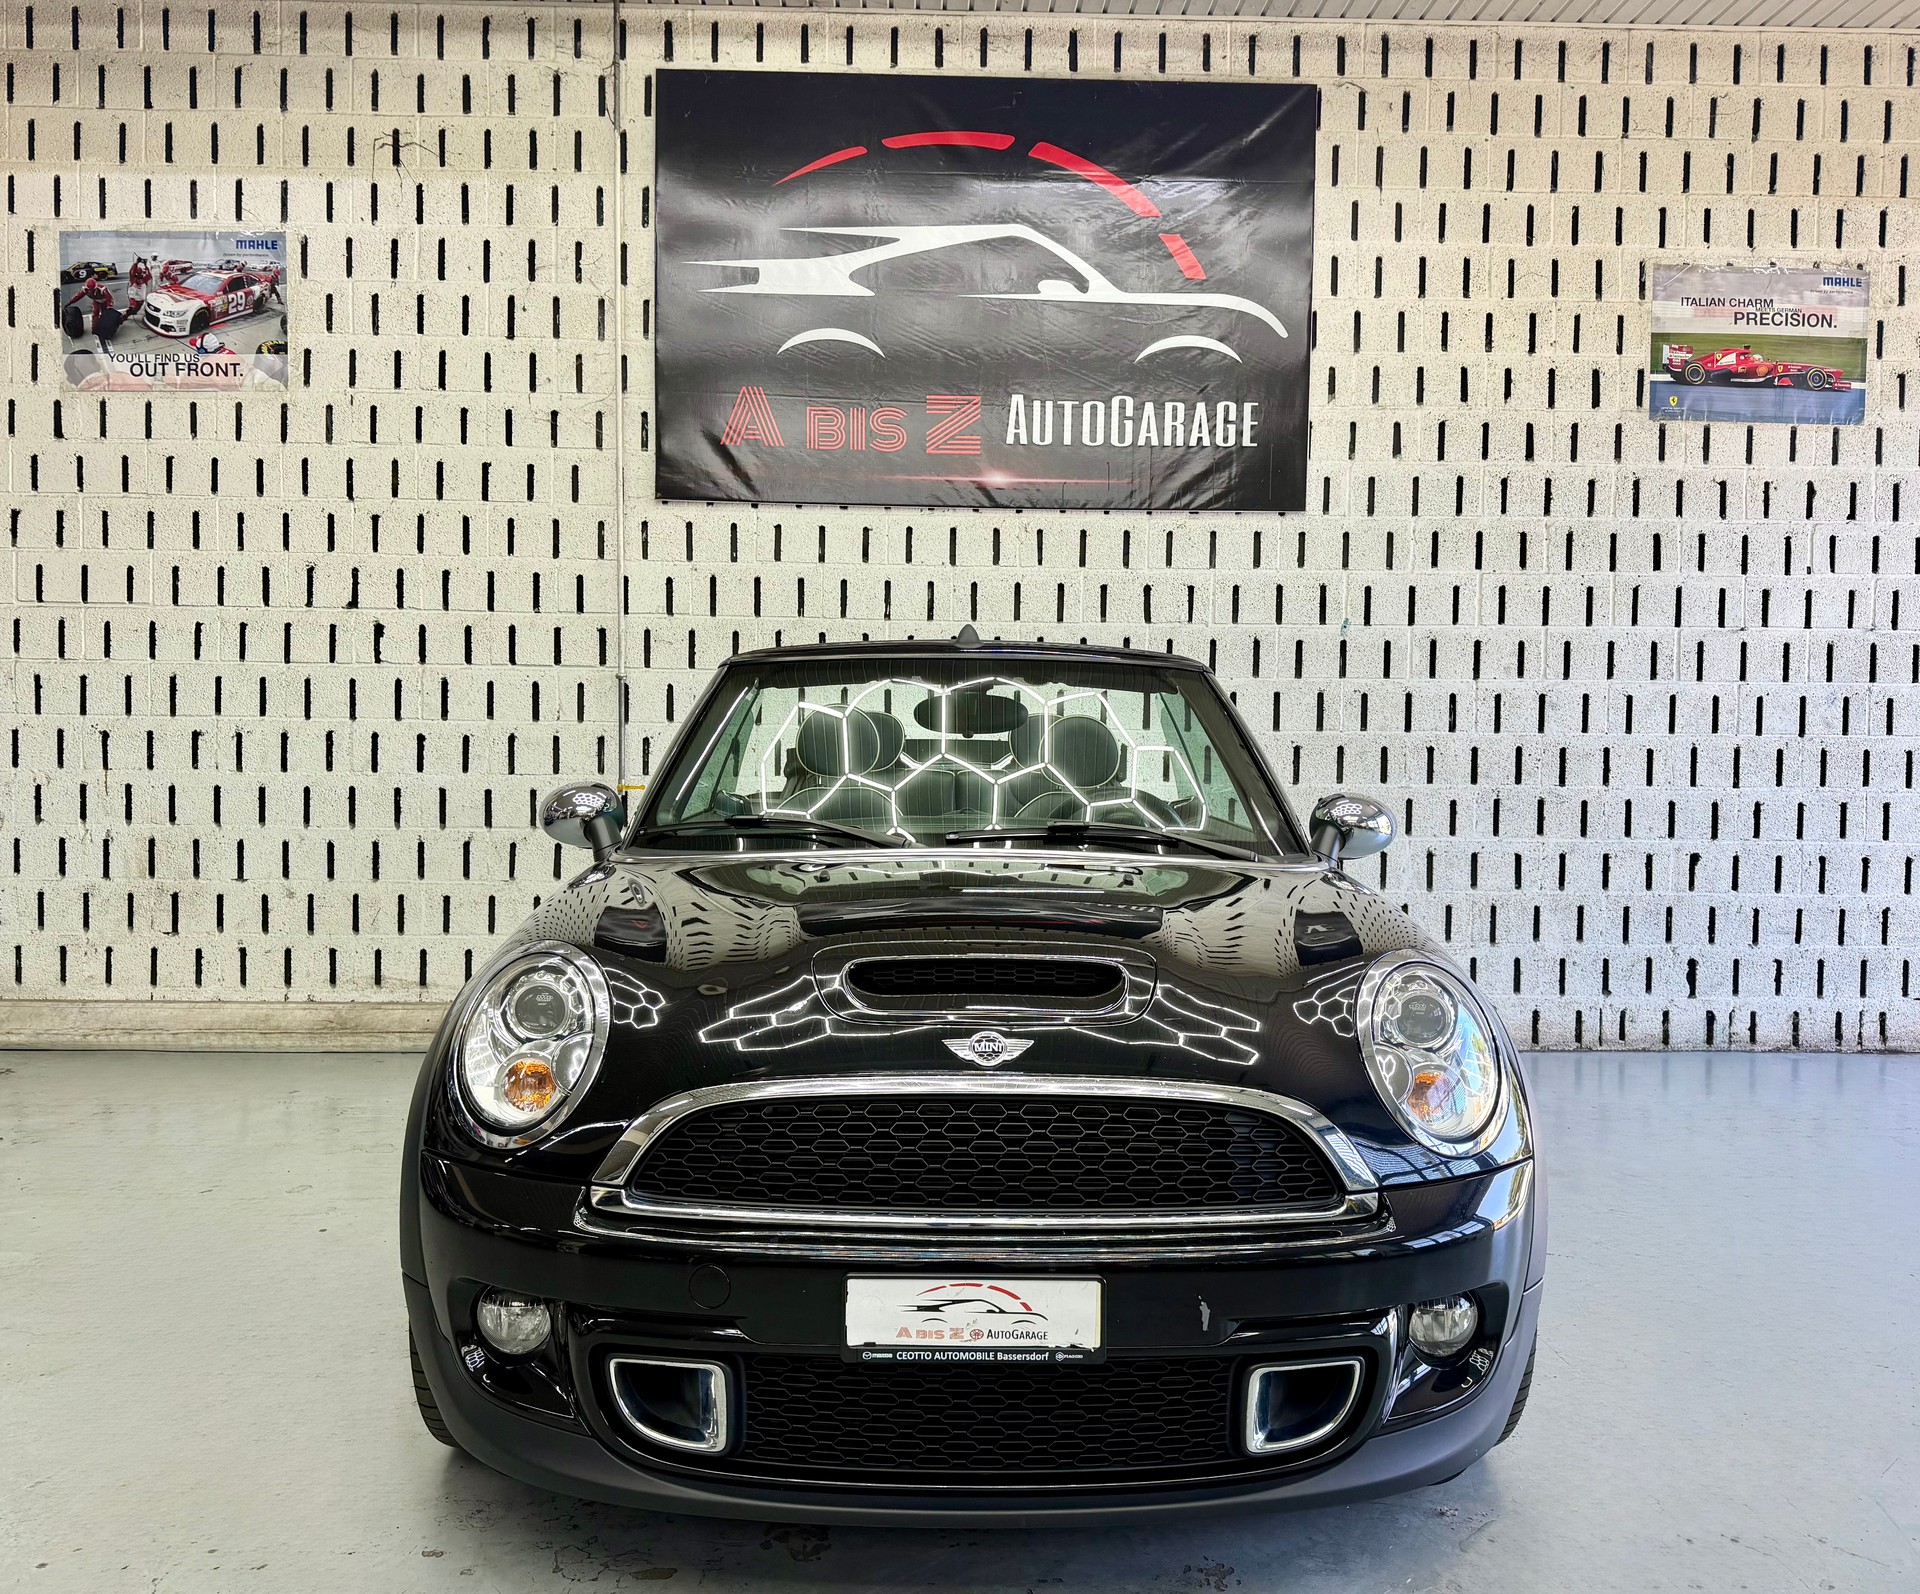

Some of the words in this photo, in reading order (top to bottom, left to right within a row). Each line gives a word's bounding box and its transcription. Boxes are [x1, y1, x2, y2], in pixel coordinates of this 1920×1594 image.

[236, 240, 278, 250] MAHLE
[79, 270, 87, 278] 9
[1823, 277, 1862, 287] MAHLE
[228, 292, 246, 314] 29
[1680, 297, 1726, 307] ITALIAN
[1728, 298, 1774, 308] CHARM
[1733, 311, 1837, 328] PRECISION.
[109, 354, 151, 362] YOU'LL
[155, 354, 180, 362] FIND
[185, 354, 200, 362] US
[130, 362, 169, 377] OUT
[175, 362, 243, 377] FRONT.
[720, 386, 785, 447] A
[806, 406, 907, 452] BIS
[926, 394, 981, 454] Z
[974, 1042, 1003, 1052] MINI
[895, 1326, 912, 1339] A
[915, 1329, 945, 1340] BIS
[949, 1327, 964, 1340] Z
[896, 1351, 932, 1360] CEOTTO
[934, 1351, 995, 1360] AUTOMOBILE
[997, 1352, 1050, 1361] Bassersdorf
